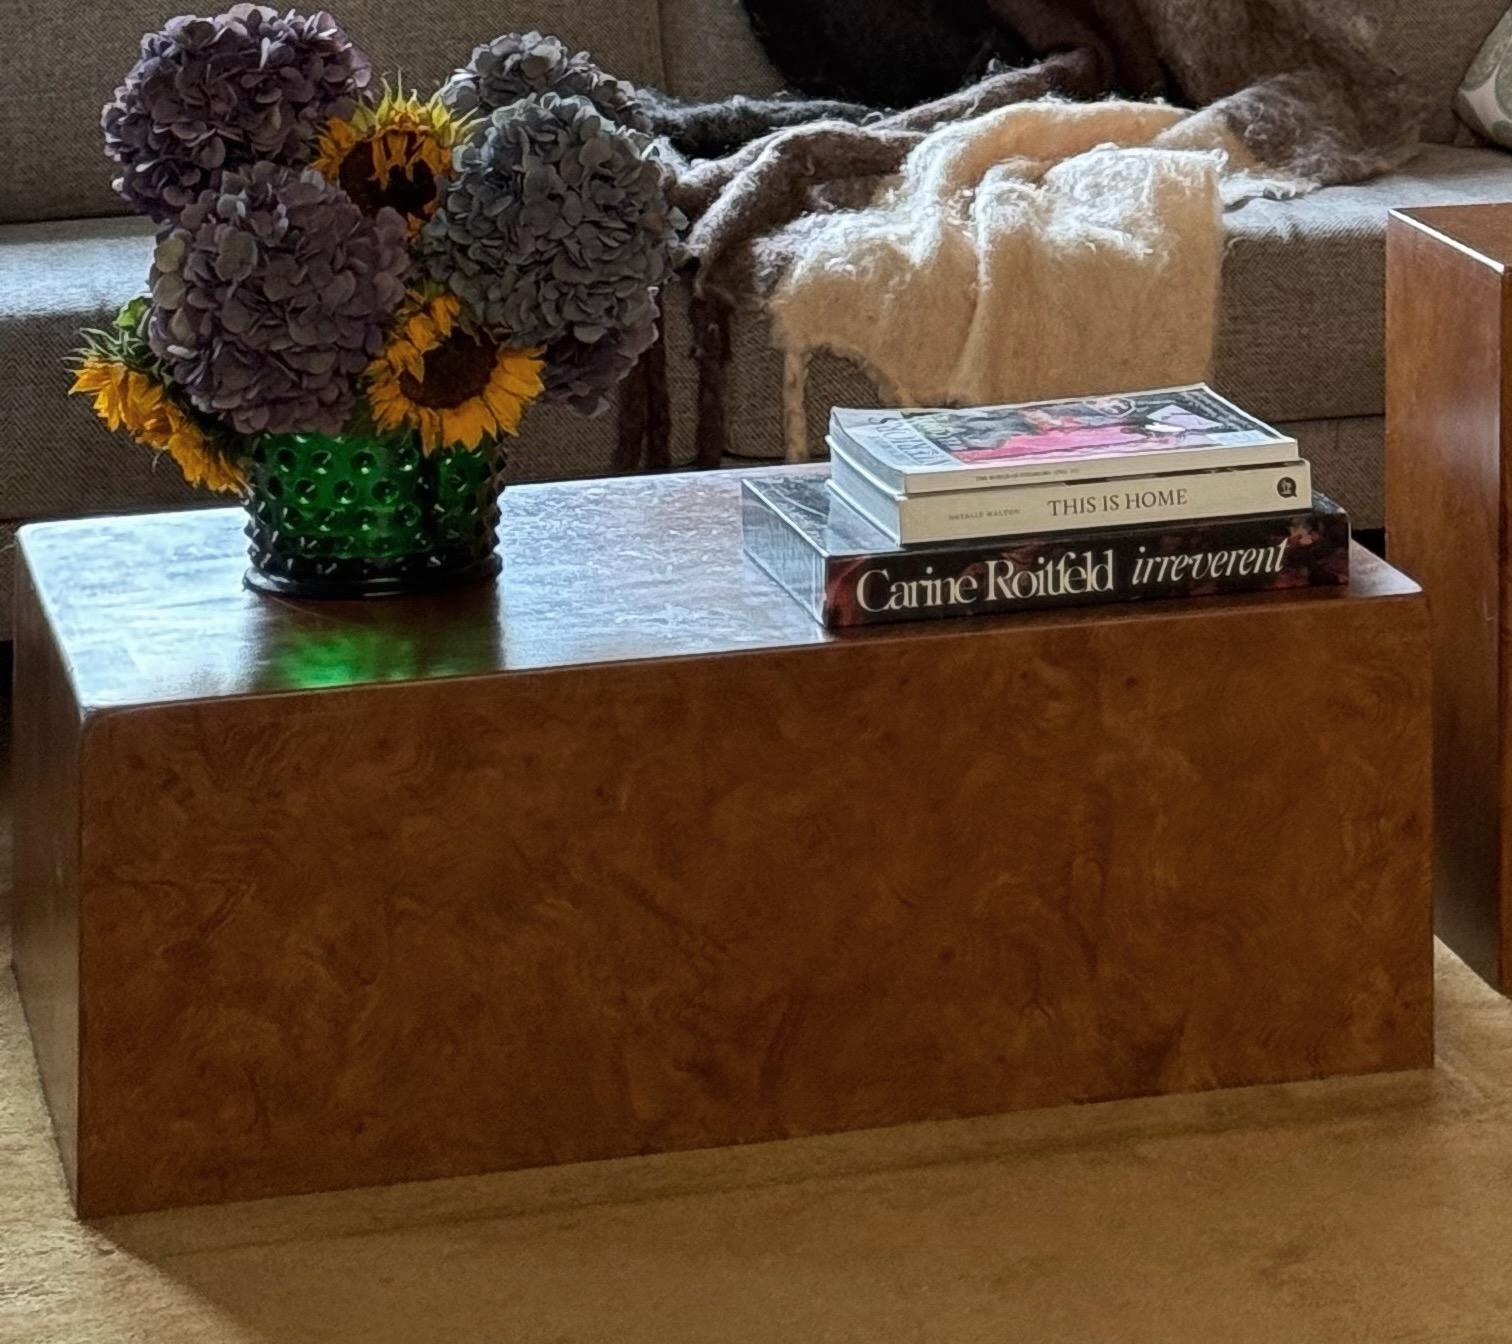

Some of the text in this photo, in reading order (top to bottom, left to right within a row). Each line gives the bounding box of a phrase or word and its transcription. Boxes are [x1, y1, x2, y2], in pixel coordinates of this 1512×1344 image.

[1047, 488, 1188, 516] THIS IS HOME
[856, 537, 1289, 612] Carine Roitfeld irreverent
